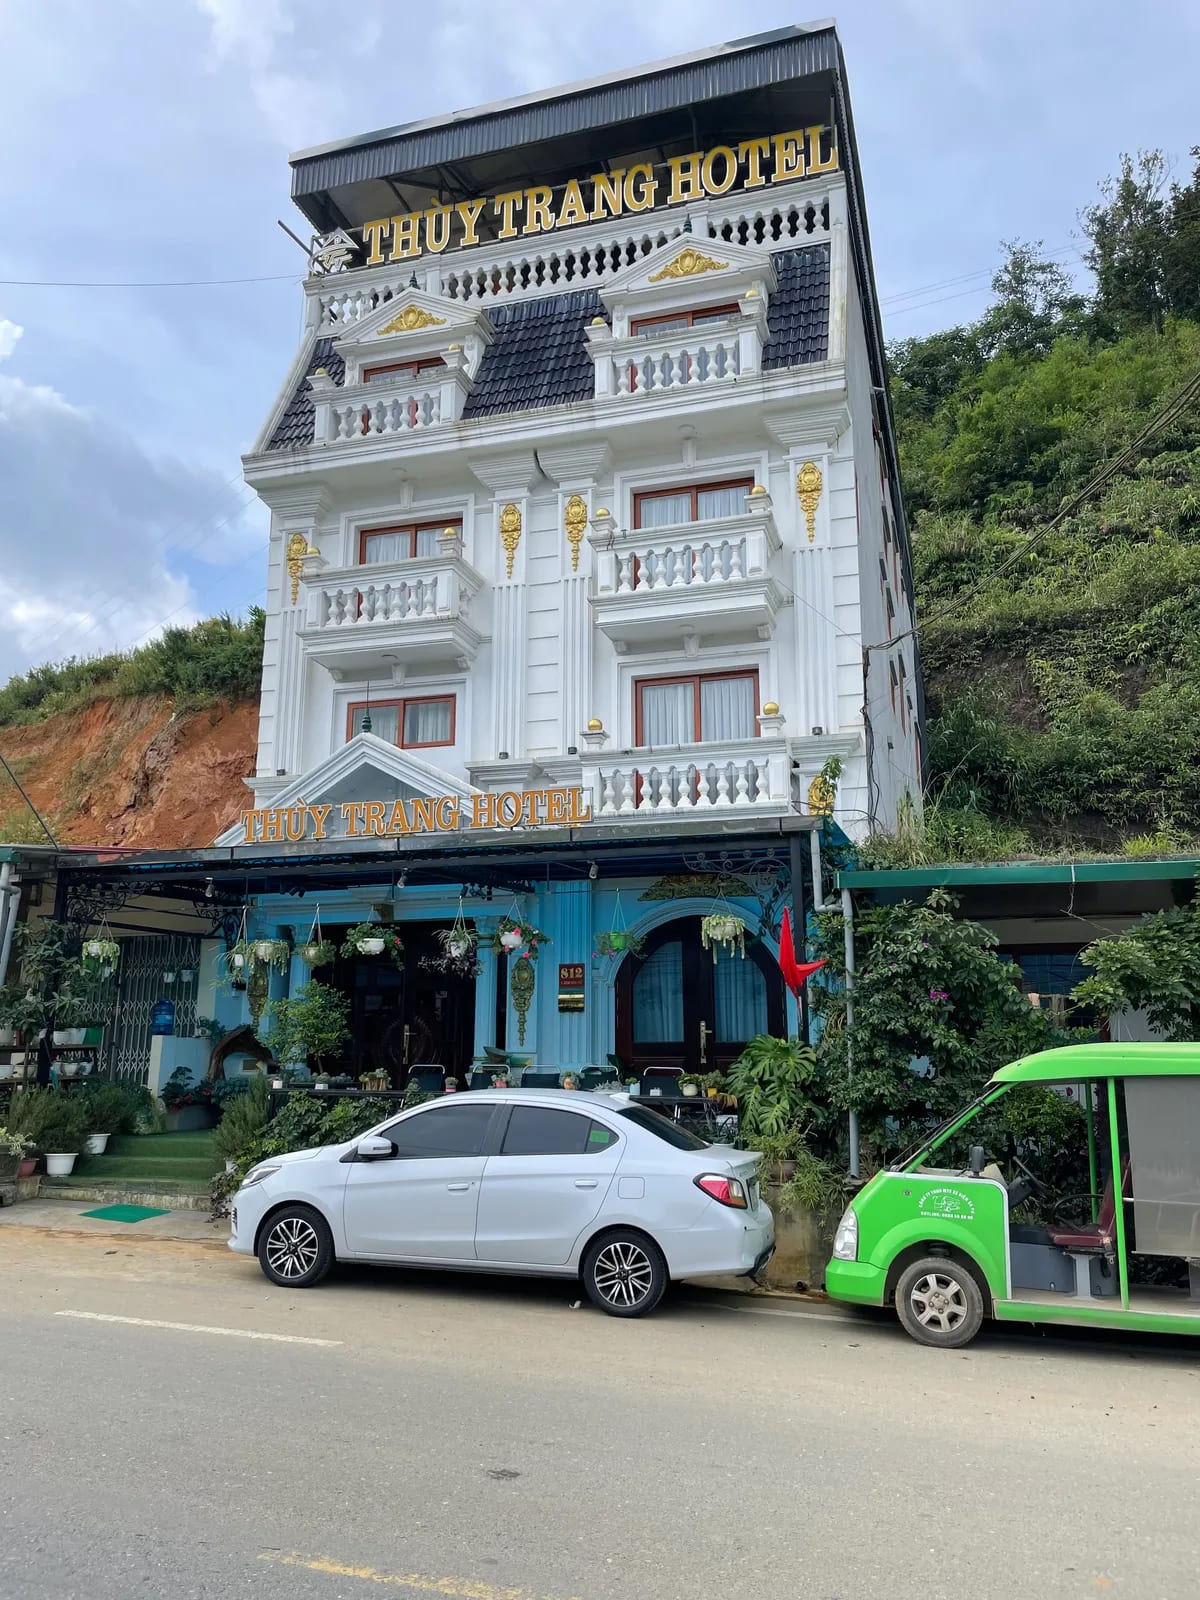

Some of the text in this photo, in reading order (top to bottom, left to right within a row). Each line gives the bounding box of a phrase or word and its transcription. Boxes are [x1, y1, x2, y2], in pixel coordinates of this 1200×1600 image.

[363, 124, 839, 267] THÙY TRANG HOTEL
[241, 786, 593, 844] THÙY TRANG HOTEL
[560, 967, 583, 979] 812
